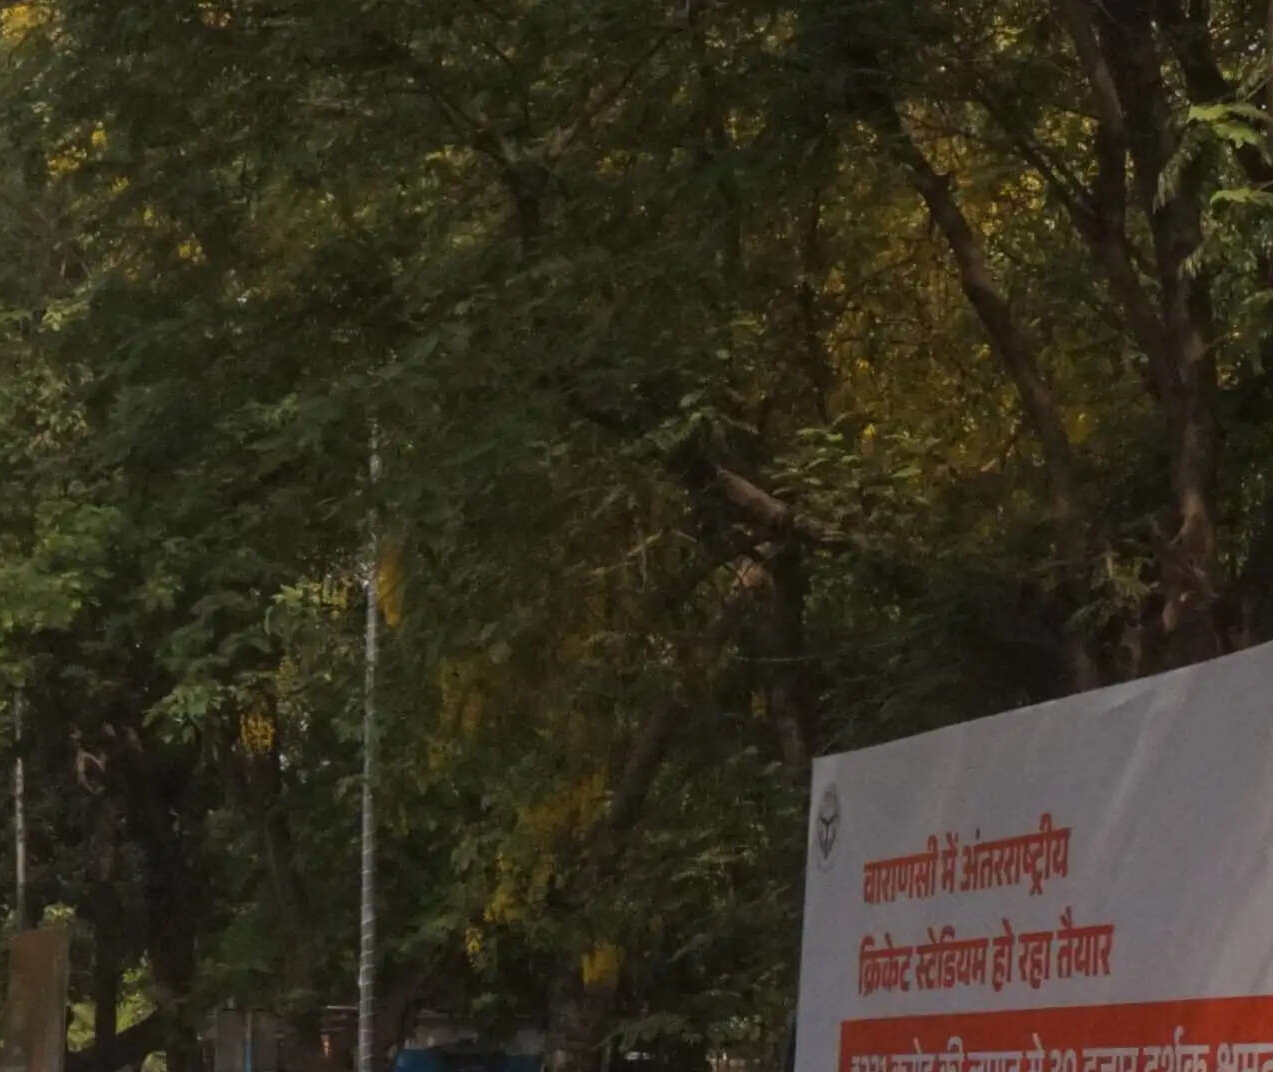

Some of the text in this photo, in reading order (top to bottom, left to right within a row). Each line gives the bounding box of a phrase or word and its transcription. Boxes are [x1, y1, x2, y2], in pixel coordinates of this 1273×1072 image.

[864, 813, 1071, 903] वाराणसी में अंतरराष्ट्रीय
[858, 906, 1114, 996] क्रिकेट स्टेडियम हो रहा तैयार
